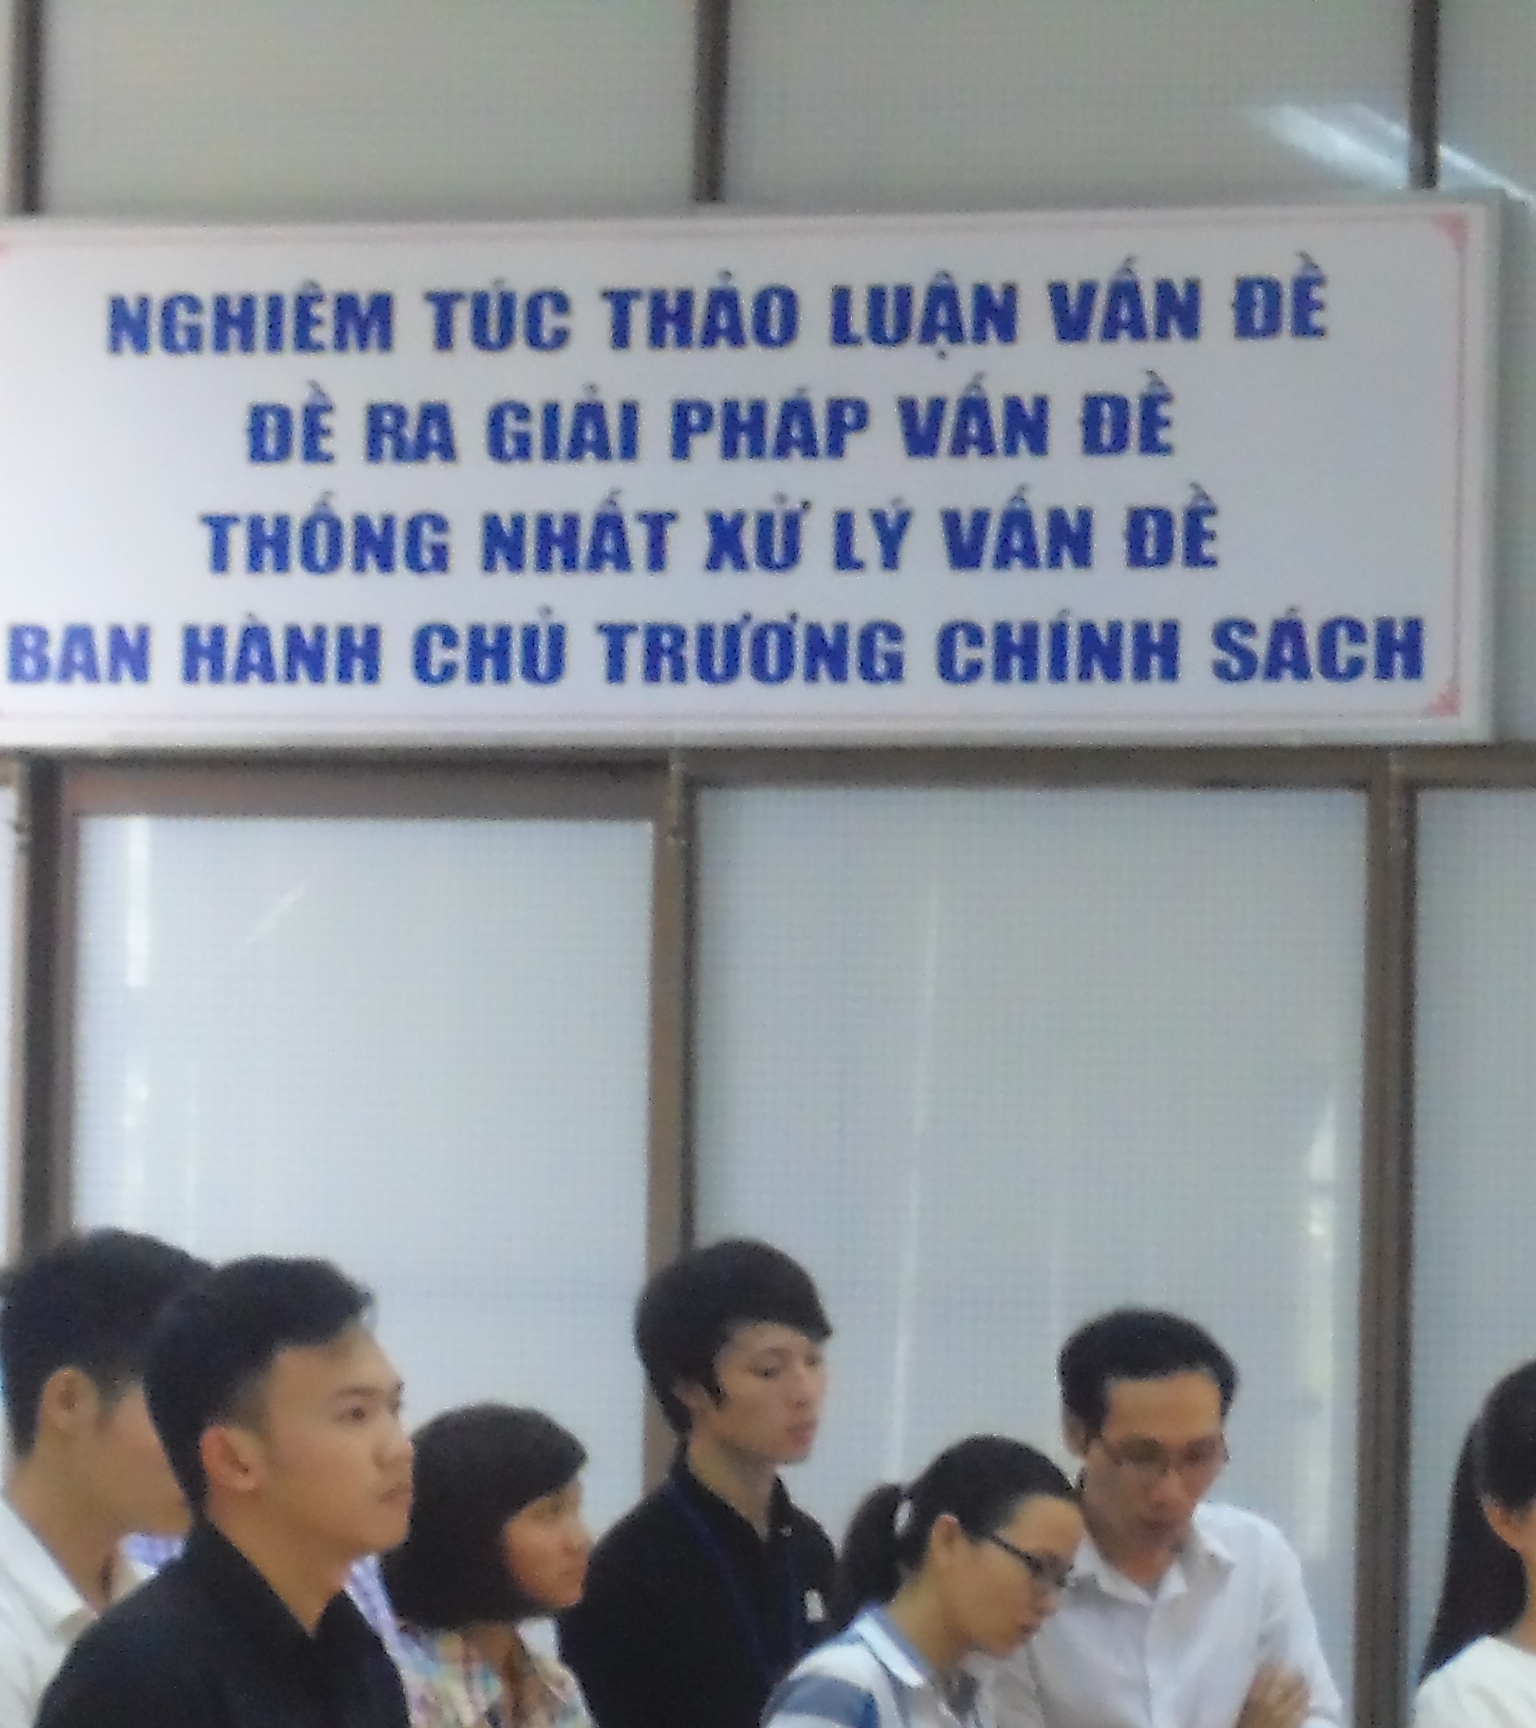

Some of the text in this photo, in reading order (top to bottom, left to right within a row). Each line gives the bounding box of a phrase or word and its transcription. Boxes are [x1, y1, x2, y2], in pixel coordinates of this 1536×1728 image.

[108, 251, 1327, 360] NGHIÊM TÚC THẢO LUẬN VẤN ĐỀ
[247, 369, 1175, 465] ĐỀ RA GIẢI PHÁP VẤN ĐỀ
[199, 481, 1219, 576] THỐNG NHẤT XỬ LÝ VẤN ĐỀ
[7, 606, 1426, 687] BAN HÀNH CHỦ TRƯƠNG CHÍNH SÁCH
